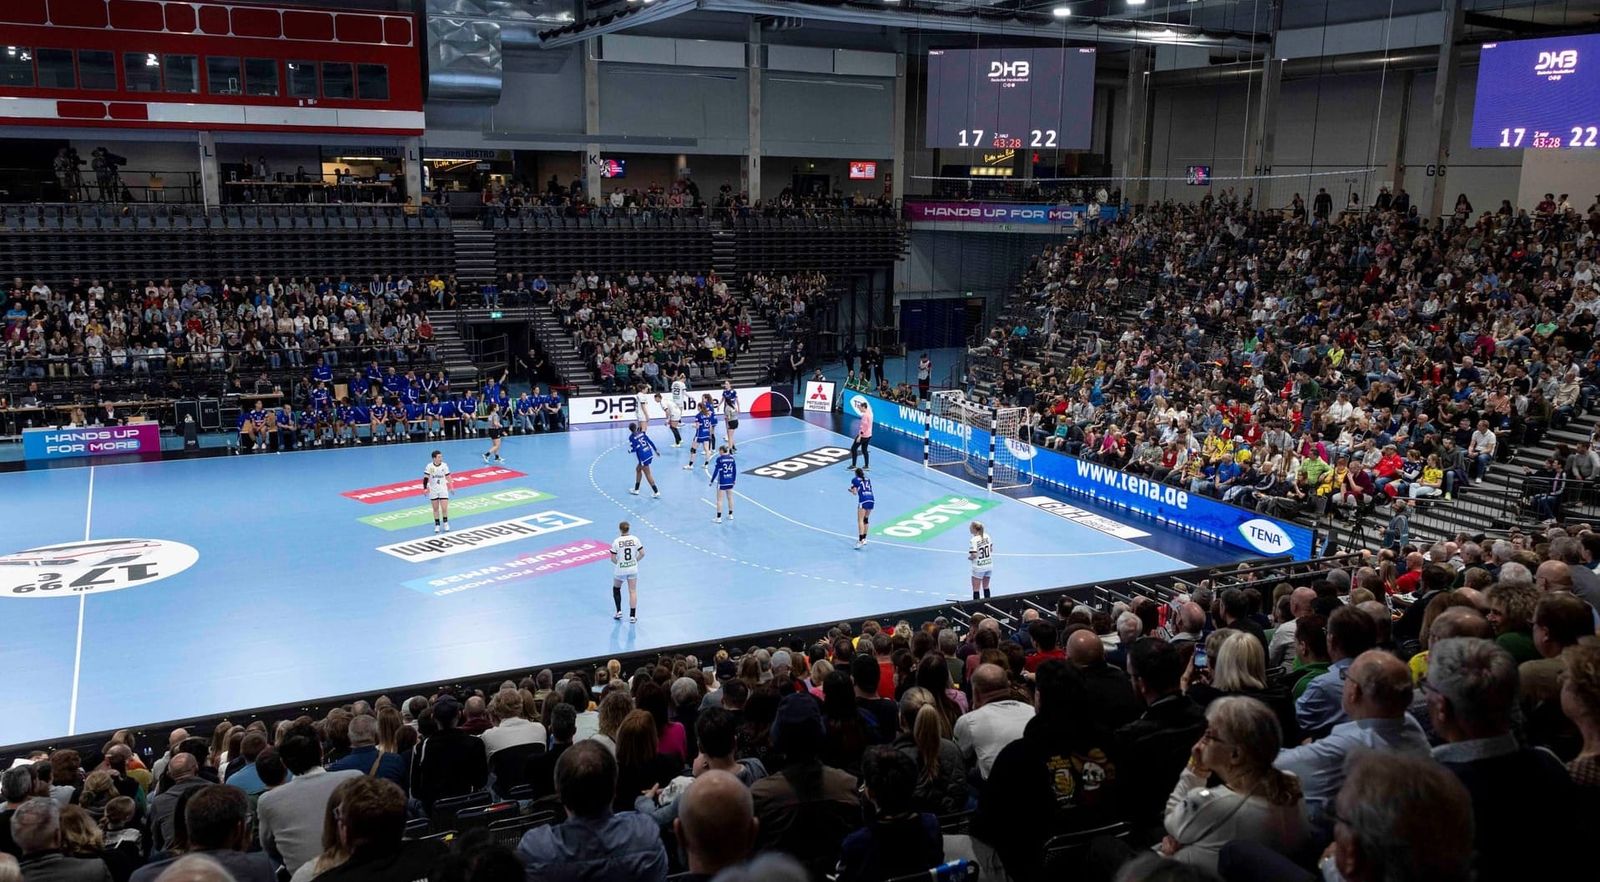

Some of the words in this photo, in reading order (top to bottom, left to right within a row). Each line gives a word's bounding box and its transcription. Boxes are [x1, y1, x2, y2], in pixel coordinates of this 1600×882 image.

[1534, 50, 1578, 70] DHB
[988, 61, 1030, 77] DHB
[958, 129, 984, 147] 17
[993, 138, 1022, 148] 43:28
[1031, 129, 1057, 147] 22
[1499, 127, 1526, 147] 17
[1533, 137, 1561, 148] 43:28
[1569, 126, 1598, 147] 22
[204, 145, 212, 157] L
[409, 149, 417, 161] L
[589, 154, 598, 165] K
[924, 207, 981, 217] HANDS
[984, 209, 1007, 217] UP
[1010, 209, 1044, 218] FOR
[591, 396, 637, 415] DHB
[45, 431, 112, 443] HANDS
[114, 429, 140, 439] UP
[46, 444, 85, 454] FOR
[90, 441, 139, 451] MORE
[722, 463, 734, 474] 34
[753, 447, 850, 479] atlas
[859, 481, 871, 492] 14
[1076, 459, 1188, 510] www.tena.de
[883, 497, 982, 537] ALSCO
[390, 522, 537, 556] Haushahn
[1250, 525, 1282, 546] TENA
[504, 543, 596, 568] FRAUEN
[624, 547, 632, 561] 8
[977, 545, 990, 560] 30
[69, 562, 159, 587] 17
[12, 581, 63, 594] 99
